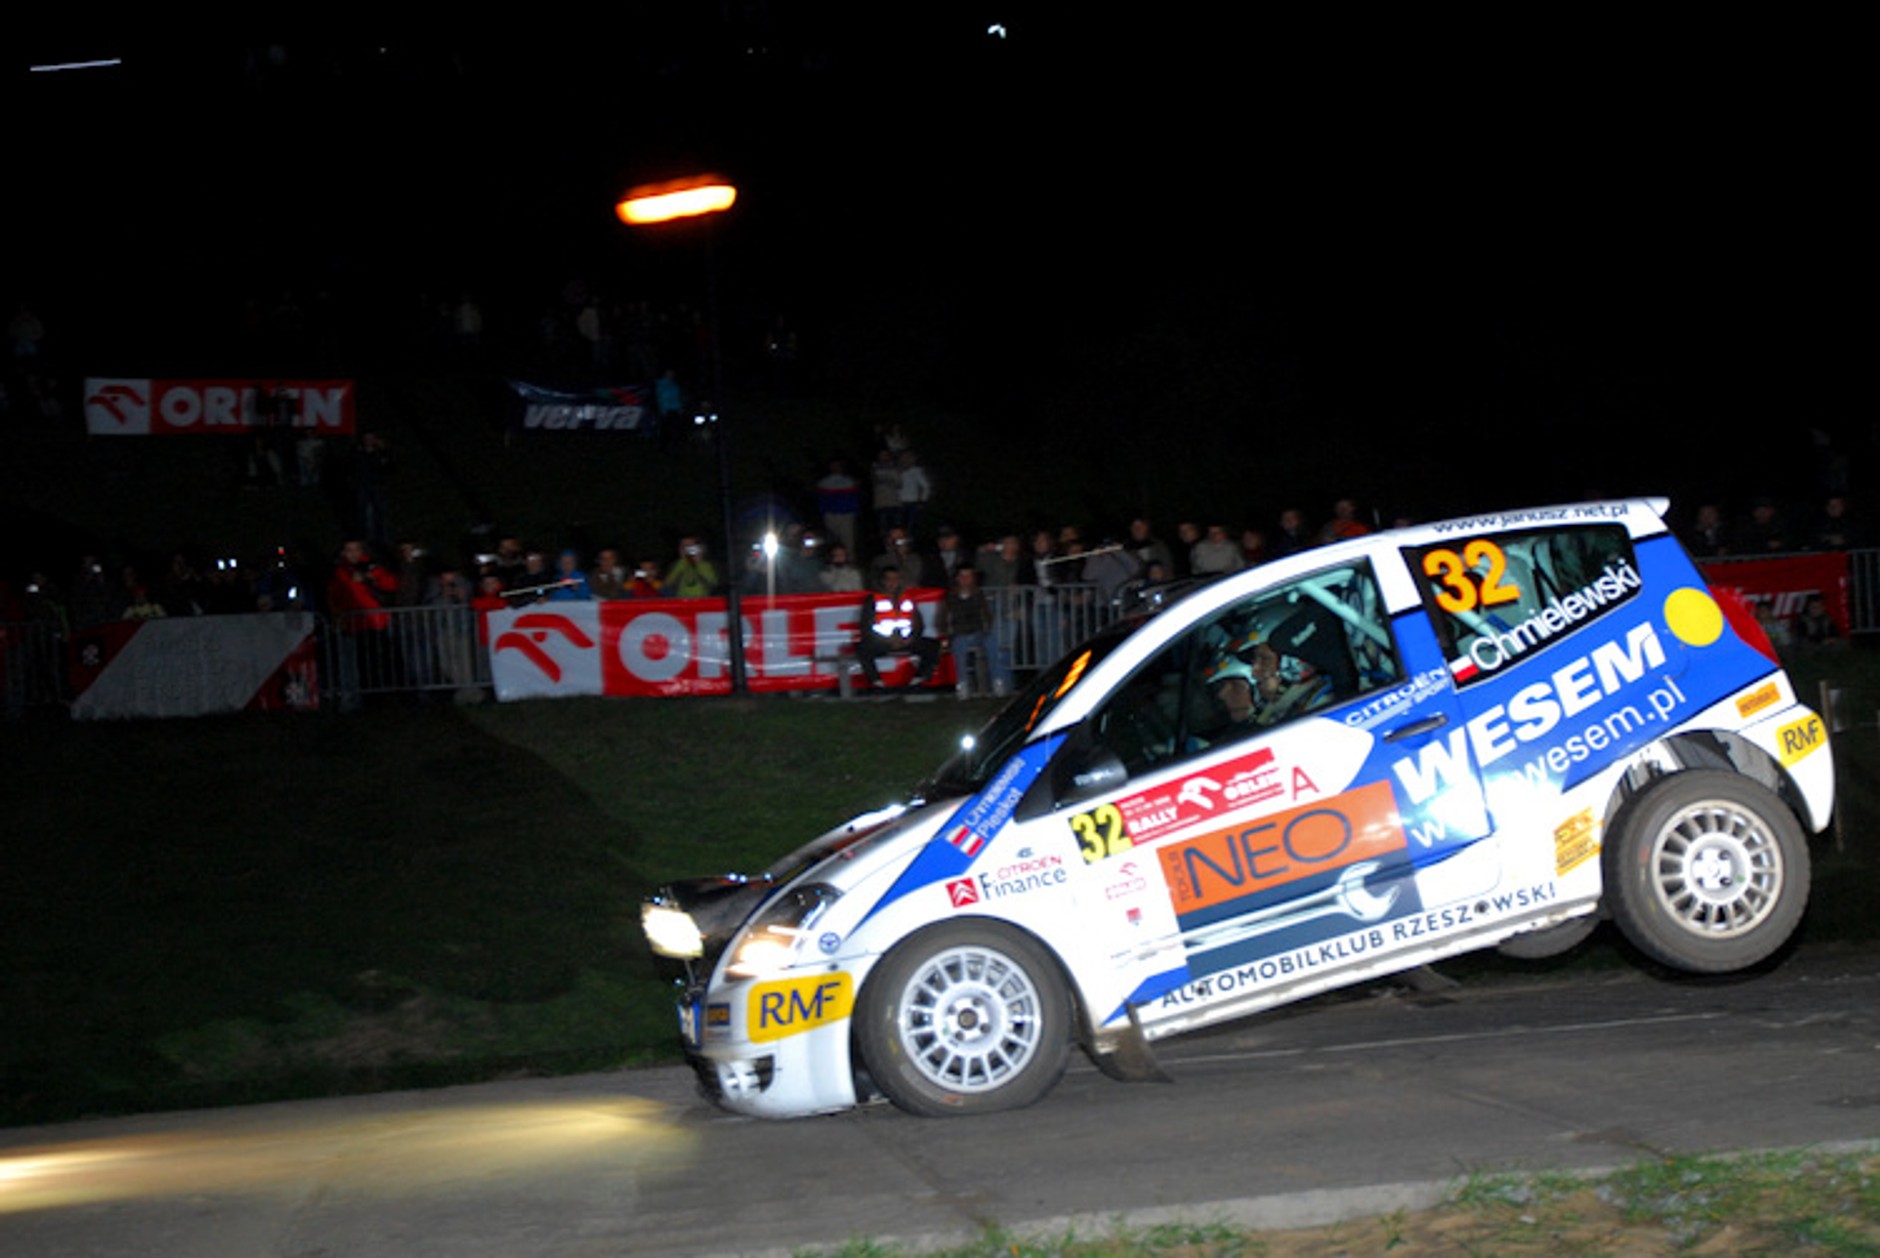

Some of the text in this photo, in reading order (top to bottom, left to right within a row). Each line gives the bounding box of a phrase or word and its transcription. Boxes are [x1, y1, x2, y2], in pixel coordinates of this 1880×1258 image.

[1423, 539, 1521, 614] 32
[1469, 558, 1643, 671] Chmielewski
[1391, 620, 1668, 806] WESEM
[1782, 718, 1820, 755] RMF
[1291, 765, 1320, 801] A
[1071, 802, 1133, 863] 32
[1127, 806, 1180, 835] RALLY
[978, 867, 1067, 901] Finance
[1183, 808, 1352, 899] NEO
[1161, 932, 1385, 1008] AUTOMOBILKLUB
[759, 981, 842, 1029] RMF
